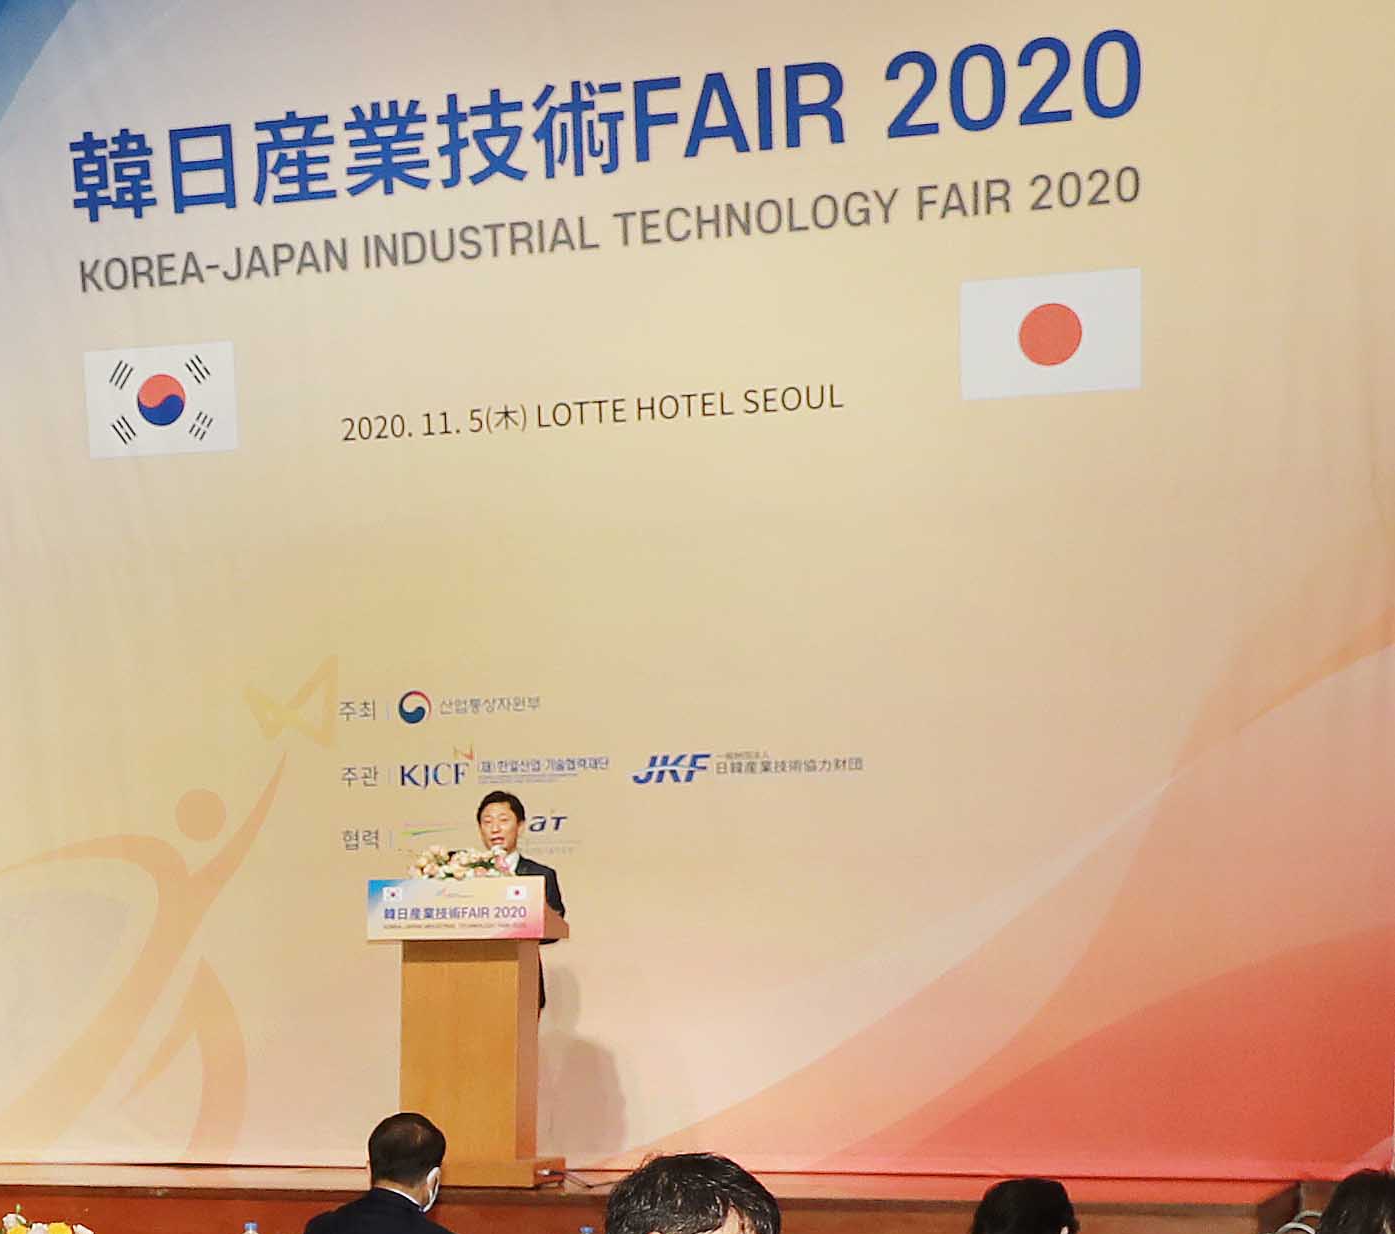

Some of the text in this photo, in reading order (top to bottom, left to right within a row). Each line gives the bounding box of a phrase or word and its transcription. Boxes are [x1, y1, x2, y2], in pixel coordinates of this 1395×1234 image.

[69, 29, 1143, 223] 韓日産業技術FAIR 2020
[79, 166, 1143, 292] KOREA-JAPAN INDUSTRIAL TECHNOLOGY FAIR 2020
[341, 384, 844, 441] 2020. 11. 5(木) LOTTE HOTEL SEOUL
[339, 700, 376, 722] 주최
[341, 764, 469, 789] 주관 KJCF
[632, 754, 712, 784] JKF
[494, 906, 527, 918] 2020
